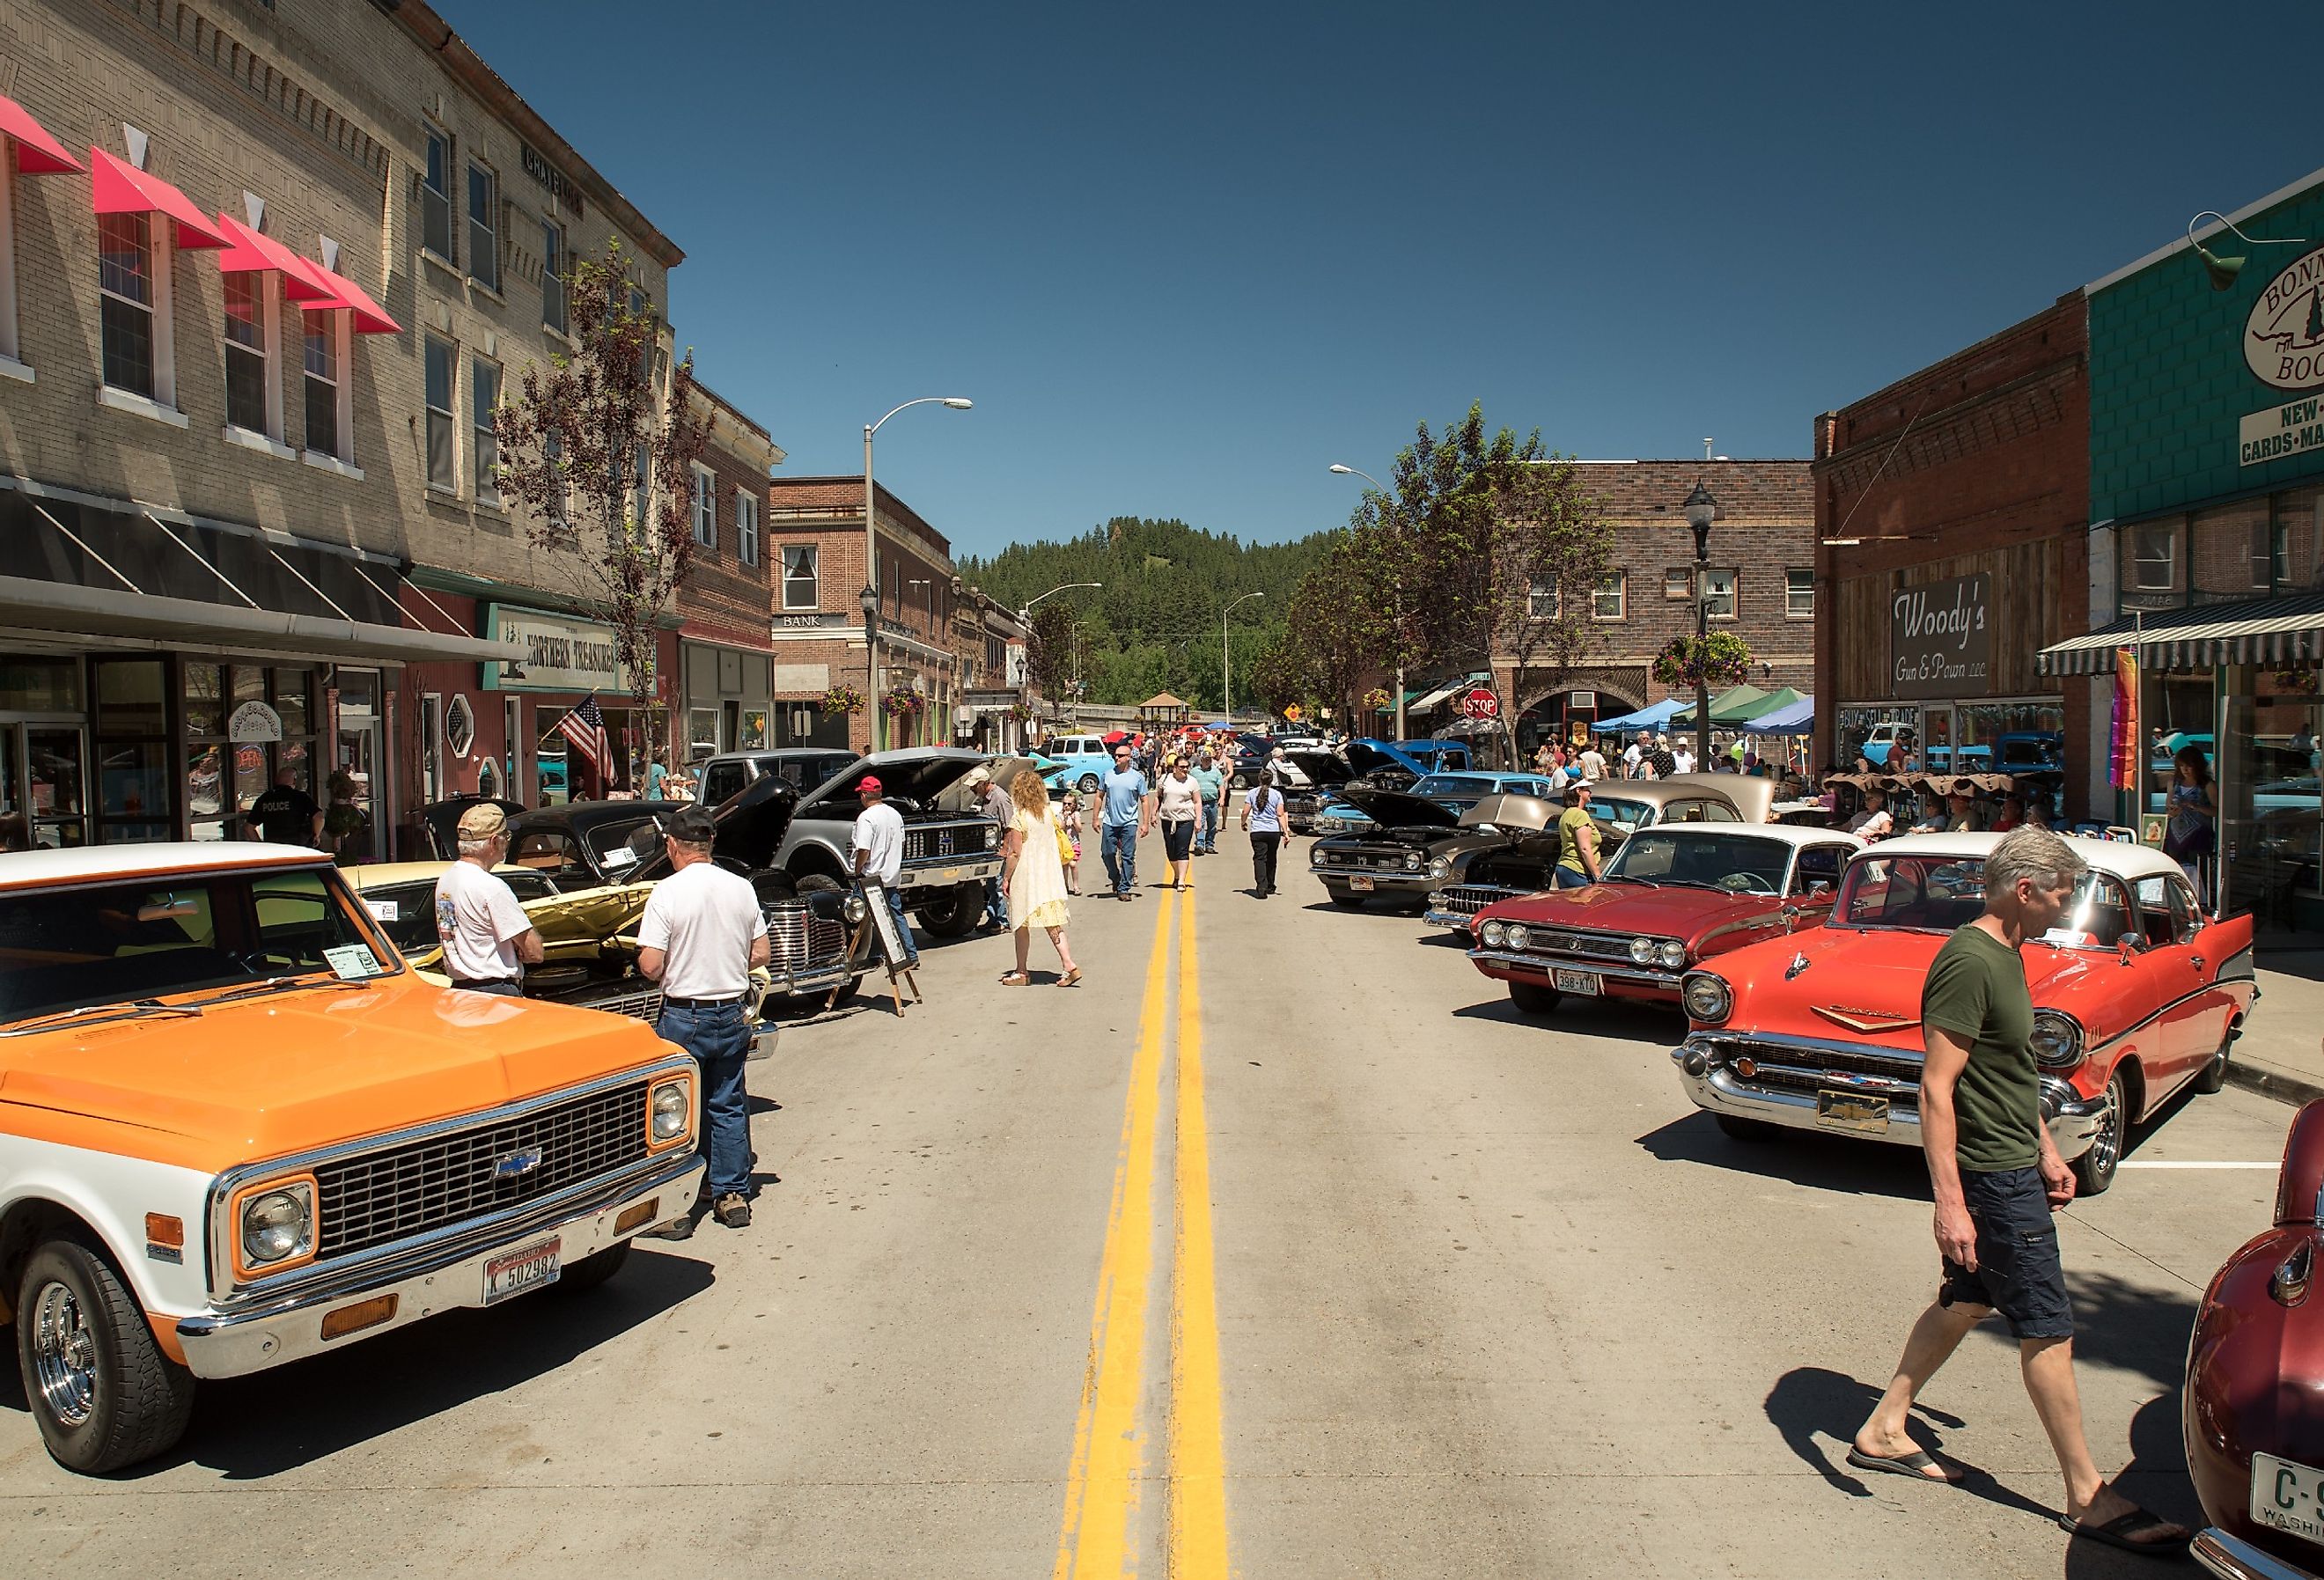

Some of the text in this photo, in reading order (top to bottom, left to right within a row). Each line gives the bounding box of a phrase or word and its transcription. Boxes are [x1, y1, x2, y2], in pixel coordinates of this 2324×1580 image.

[2281, 399, 2319, 428] NEW
[783, 615, 820, 627] BANK
[1894, 581, 1984, 650] Woody's
[526, 634, 614, 673] NORTHERN TREASURES
[1895, 656, 1916, 681] Gun
[1919, 654, 1929, 680] &
[1931, 652, 1965, 679] Pawn
[1466, 700, 1495, 712] STOP
[1844, 709, 1859, 729] BUY
[1865, 709, 1881, 730] SELL
[262, 801, 290, 812] POLICE
[512, 1247, 540, 1263] IDAHO
[490, 1273, 497, 1295] K
[508, 1253, 556, 1288] 502982
[2263, 1506, 2324, 1537] WASHI
